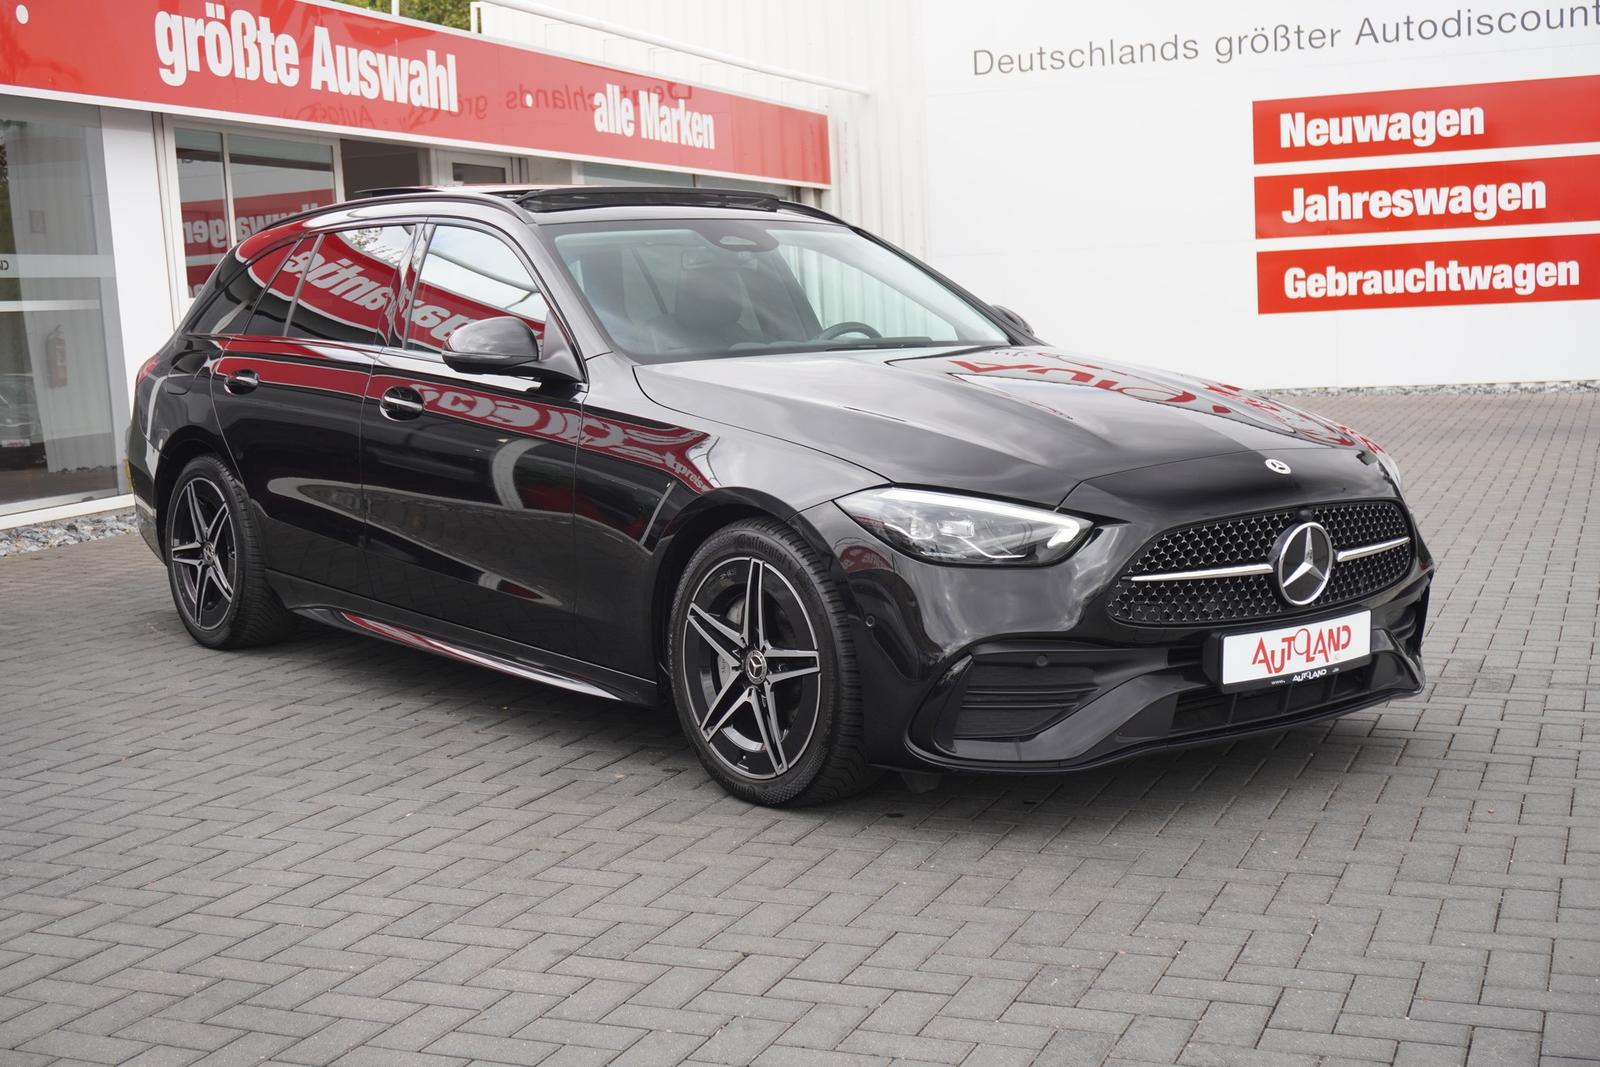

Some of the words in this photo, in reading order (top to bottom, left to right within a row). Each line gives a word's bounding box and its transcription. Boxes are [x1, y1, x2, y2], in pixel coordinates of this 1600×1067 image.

[154, 3, 300, 87] größte
[310, 26, 459, 113] Auswahl
[973, 33, 1200, 77] Deutschlands
[1214, 24, 1342, 64] größter
[593, 83, 635, 138] alle
[638, 90, 715, 150] Marken
[1279, 105, 1485, 149] Neuwagen
[1281, 179, 1547, 224] Jahreswagen
[1283, 259, 1580, 299] Gebrauchtwagen
